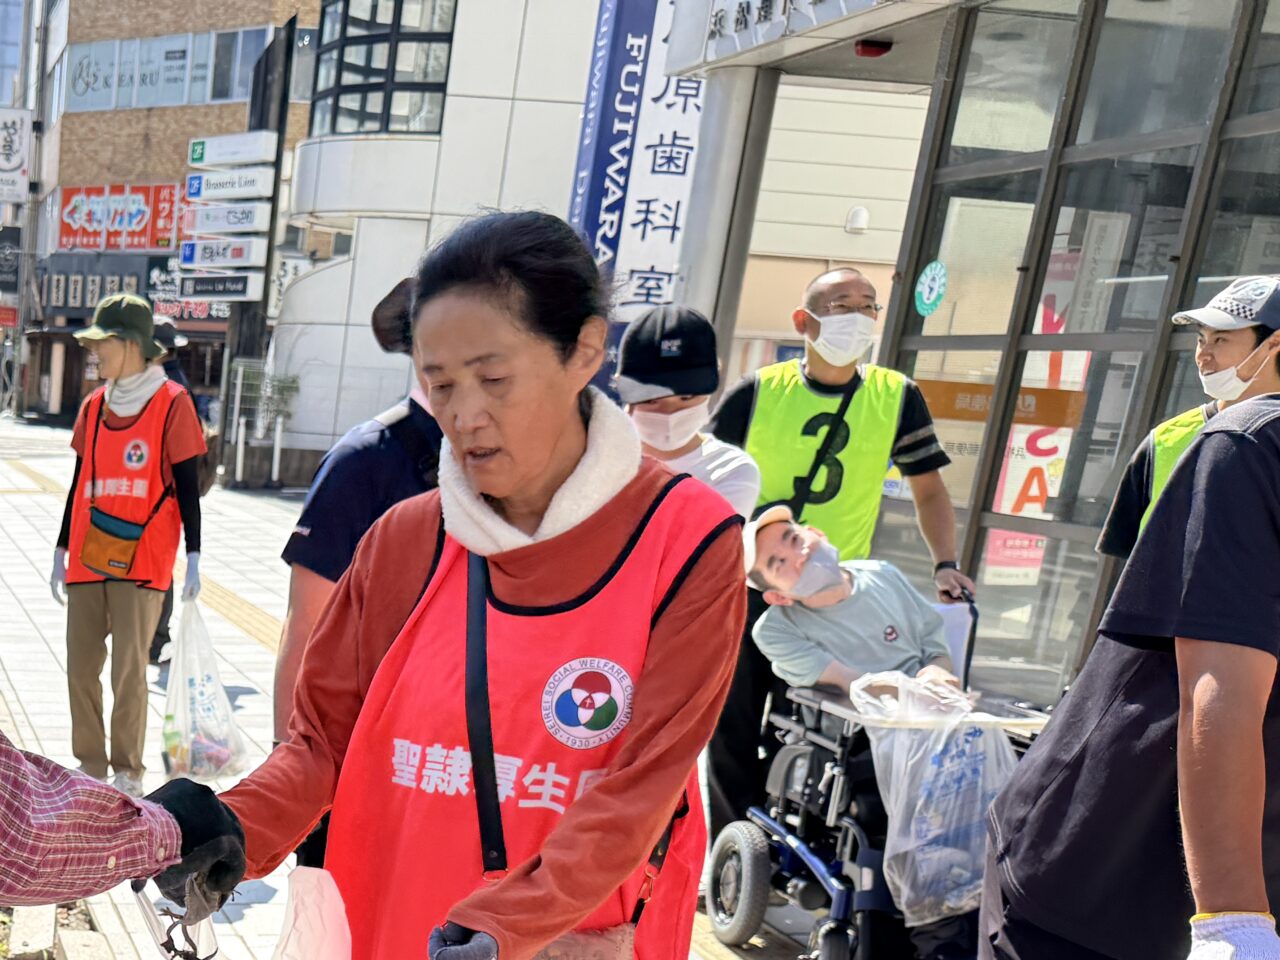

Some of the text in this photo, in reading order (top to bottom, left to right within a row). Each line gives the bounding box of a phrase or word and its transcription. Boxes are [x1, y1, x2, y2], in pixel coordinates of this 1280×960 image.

[595, 33, 648, 267] FUJIWARA
[793, 412, 850, 504] 3
[544, 663, 576, 697] SOCIAL
[578, 659, 629, 684] WELFARE
[542, 700, 560, 736] SEIREI
[566, 736, 590, 748] 1930
[391, 737, 608, 816] 聖隷厚生
